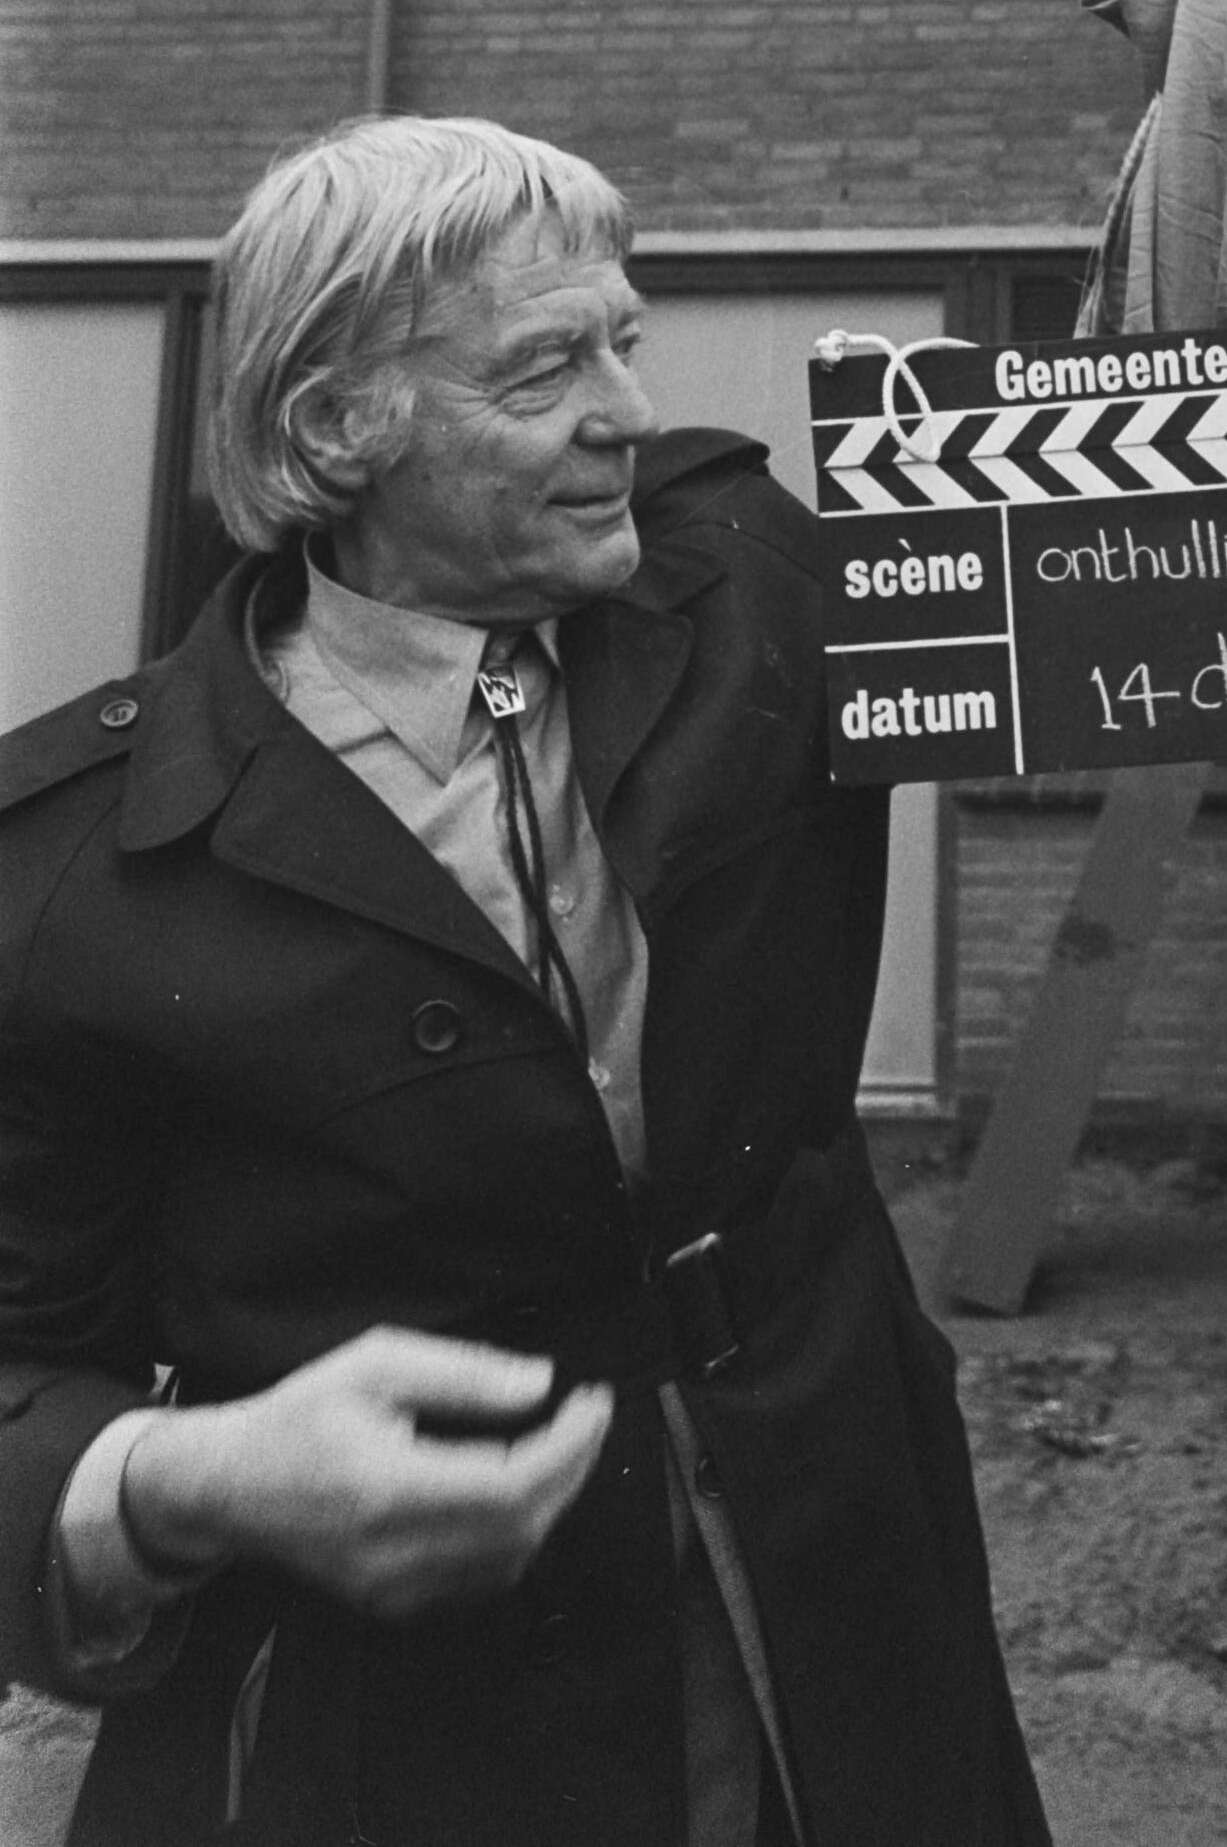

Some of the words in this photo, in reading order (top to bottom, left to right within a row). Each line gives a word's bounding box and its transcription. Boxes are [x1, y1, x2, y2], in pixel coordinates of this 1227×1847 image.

[843, 539, 985, 598] scène
[840, 687, 997, 740] datum
[1091, 662, 1181, 730] 14
